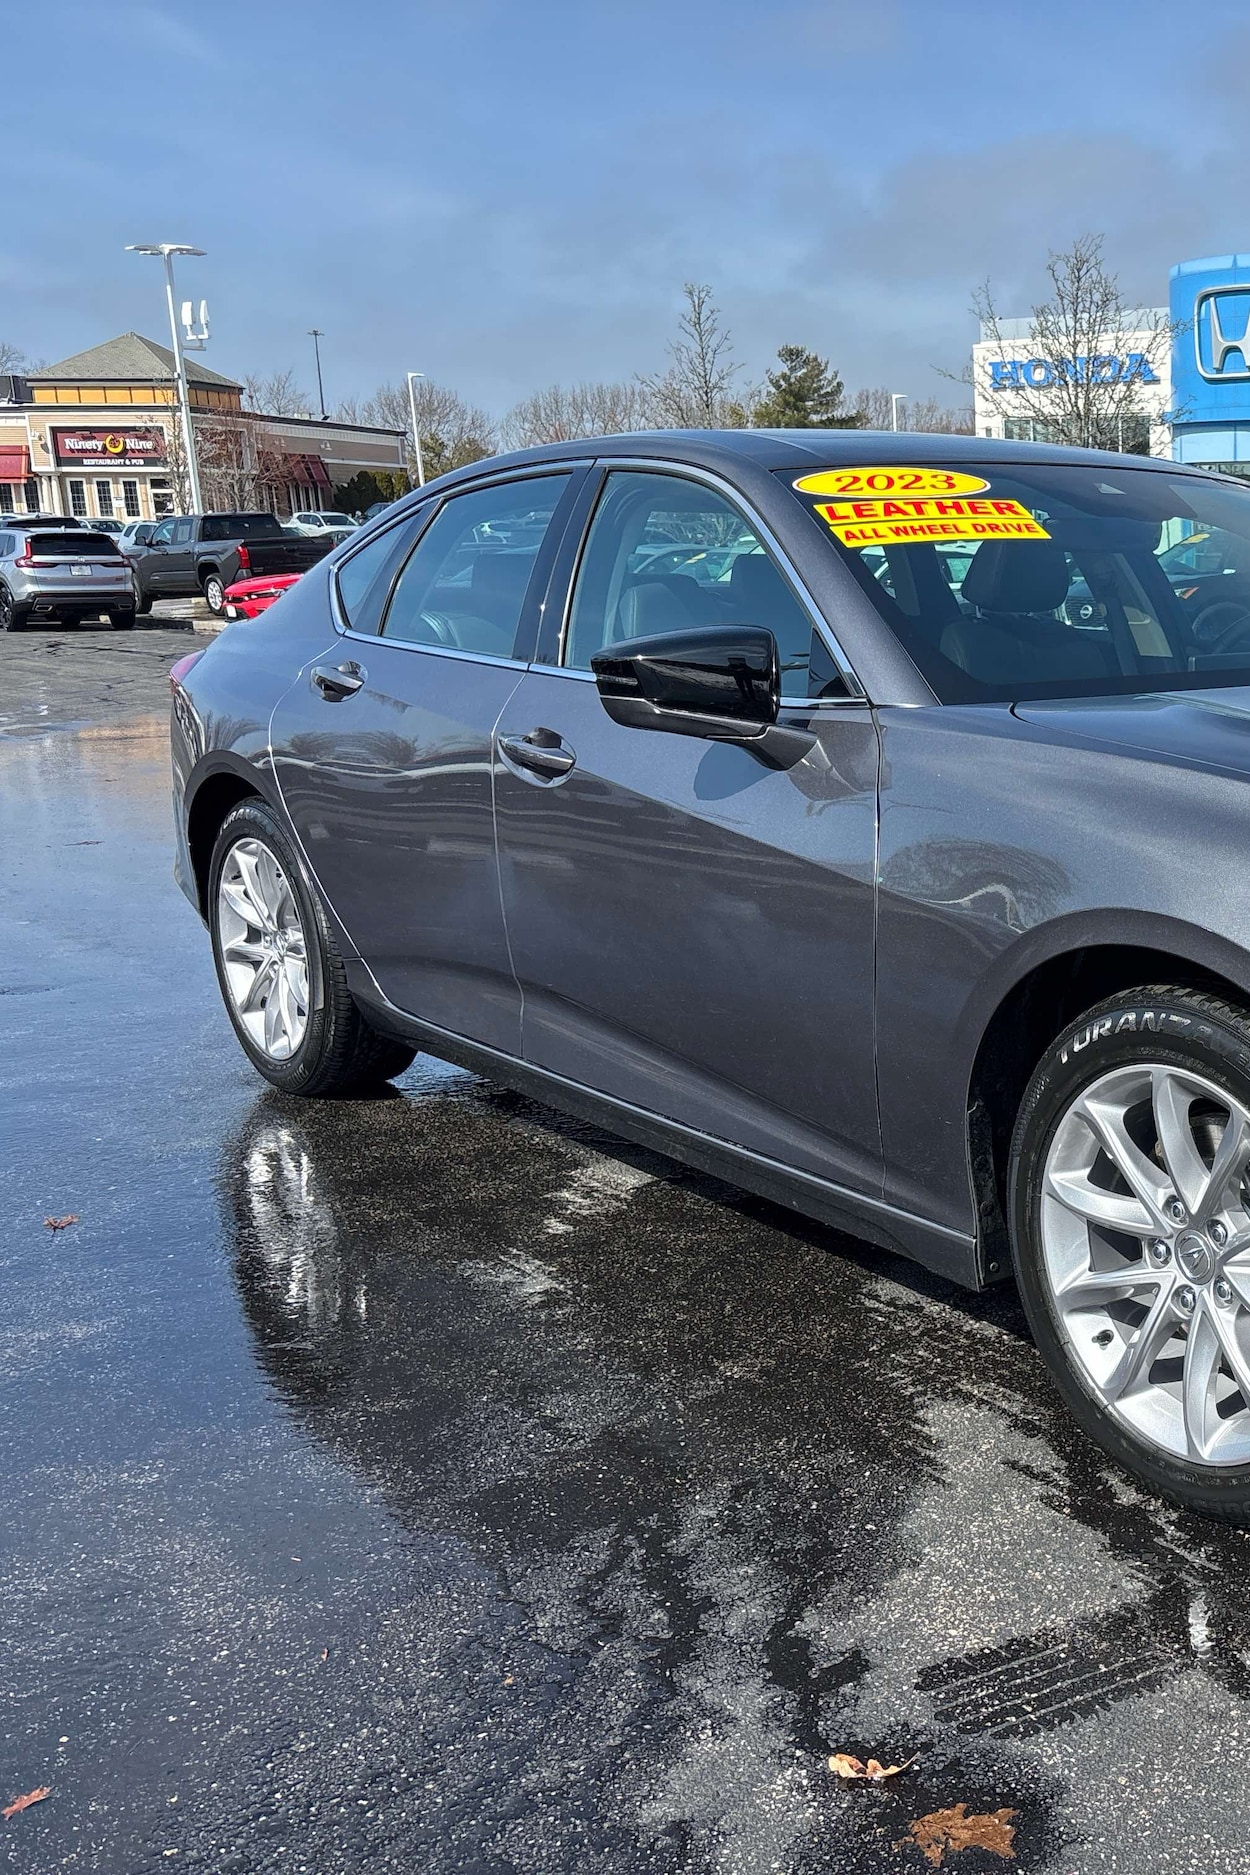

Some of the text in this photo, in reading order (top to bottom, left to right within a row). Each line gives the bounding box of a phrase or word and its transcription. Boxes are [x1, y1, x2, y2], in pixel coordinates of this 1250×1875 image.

[988, 352, 1161, 389] HONDA
[64, 438, 154, 451] Ninety Nine
[834, 474, 957, 493] 2023
[825, 500, 1028, 521] LEATHER
[844, 522, 1038, 542] ALL WHEEL DRIVE
